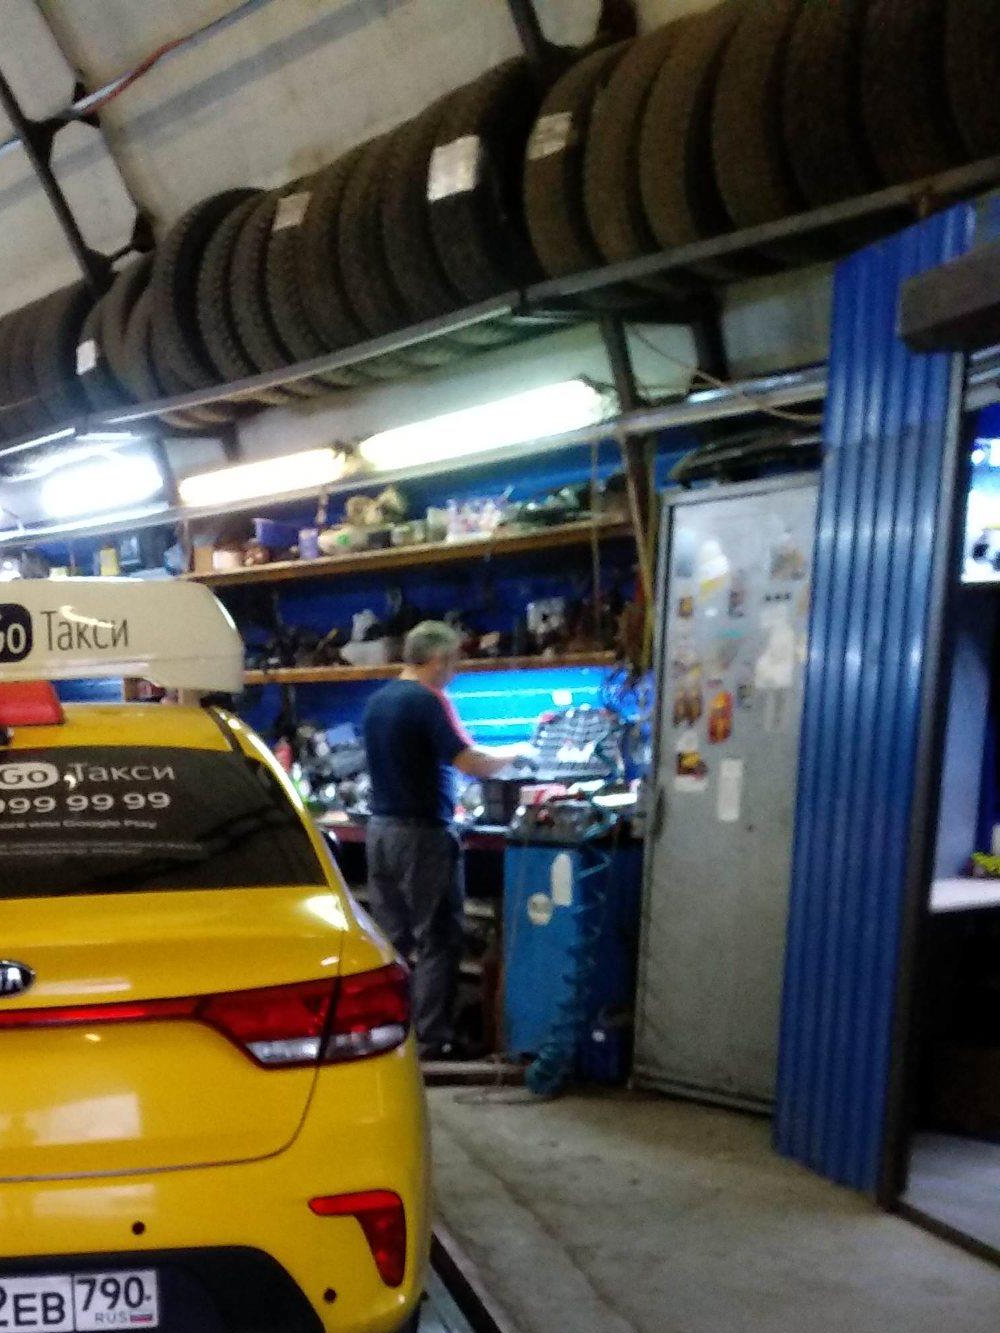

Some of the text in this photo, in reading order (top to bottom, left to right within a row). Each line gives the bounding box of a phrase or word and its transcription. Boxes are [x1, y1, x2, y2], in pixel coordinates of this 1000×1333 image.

[40, 609, 129, 651] Такси
[68, 762, 175, 783] Такси
[66, 794, 115, 812] 99
[123, 791, 171, 810] 99
[78, 1276, 145, 1313] 790
[94, 1311, 128, 1324] RUS
